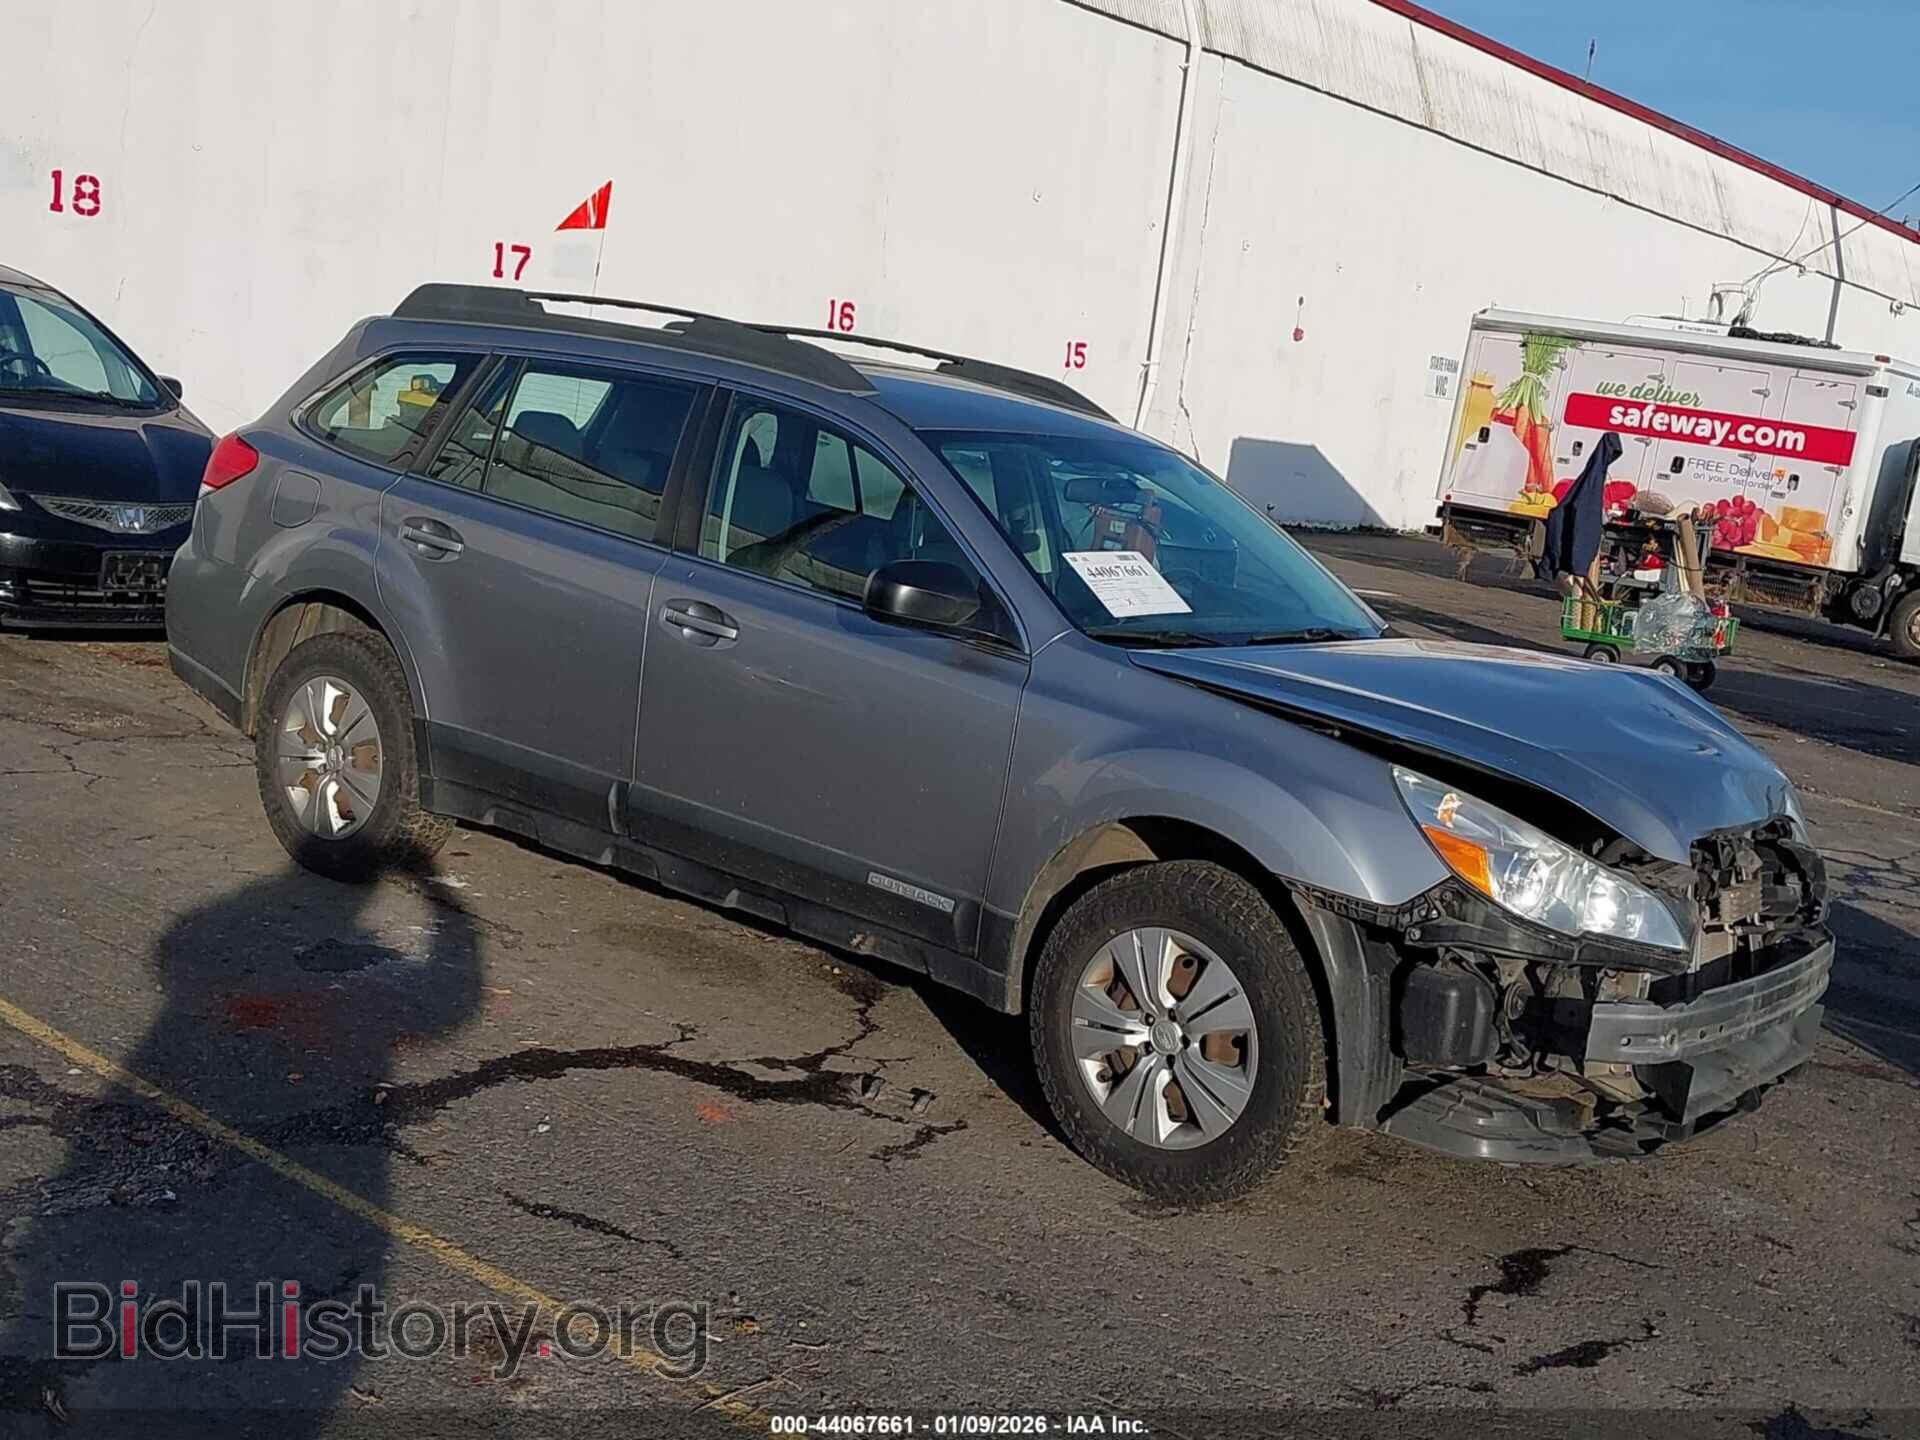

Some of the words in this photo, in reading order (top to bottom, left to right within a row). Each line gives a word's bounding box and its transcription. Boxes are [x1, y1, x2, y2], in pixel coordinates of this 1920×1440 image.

[49, 169, 102, 217] 18
[492, 242, 532, 281] 17
[826, 298, 856, 333] 16
[1064, 341, 1088, 369] 15
[1596, 381, 1627, 397] we
[1629, 382, 1704, 408] deliver
[1609, 403, 1806, 452] safeway.com
[1687, 457, 1726, 473] FREE
[1729, 464, 1784, 484] Delivery
[1708, 474, 1730, 482] your
[1086, 564, 1149, 578] 44067661
